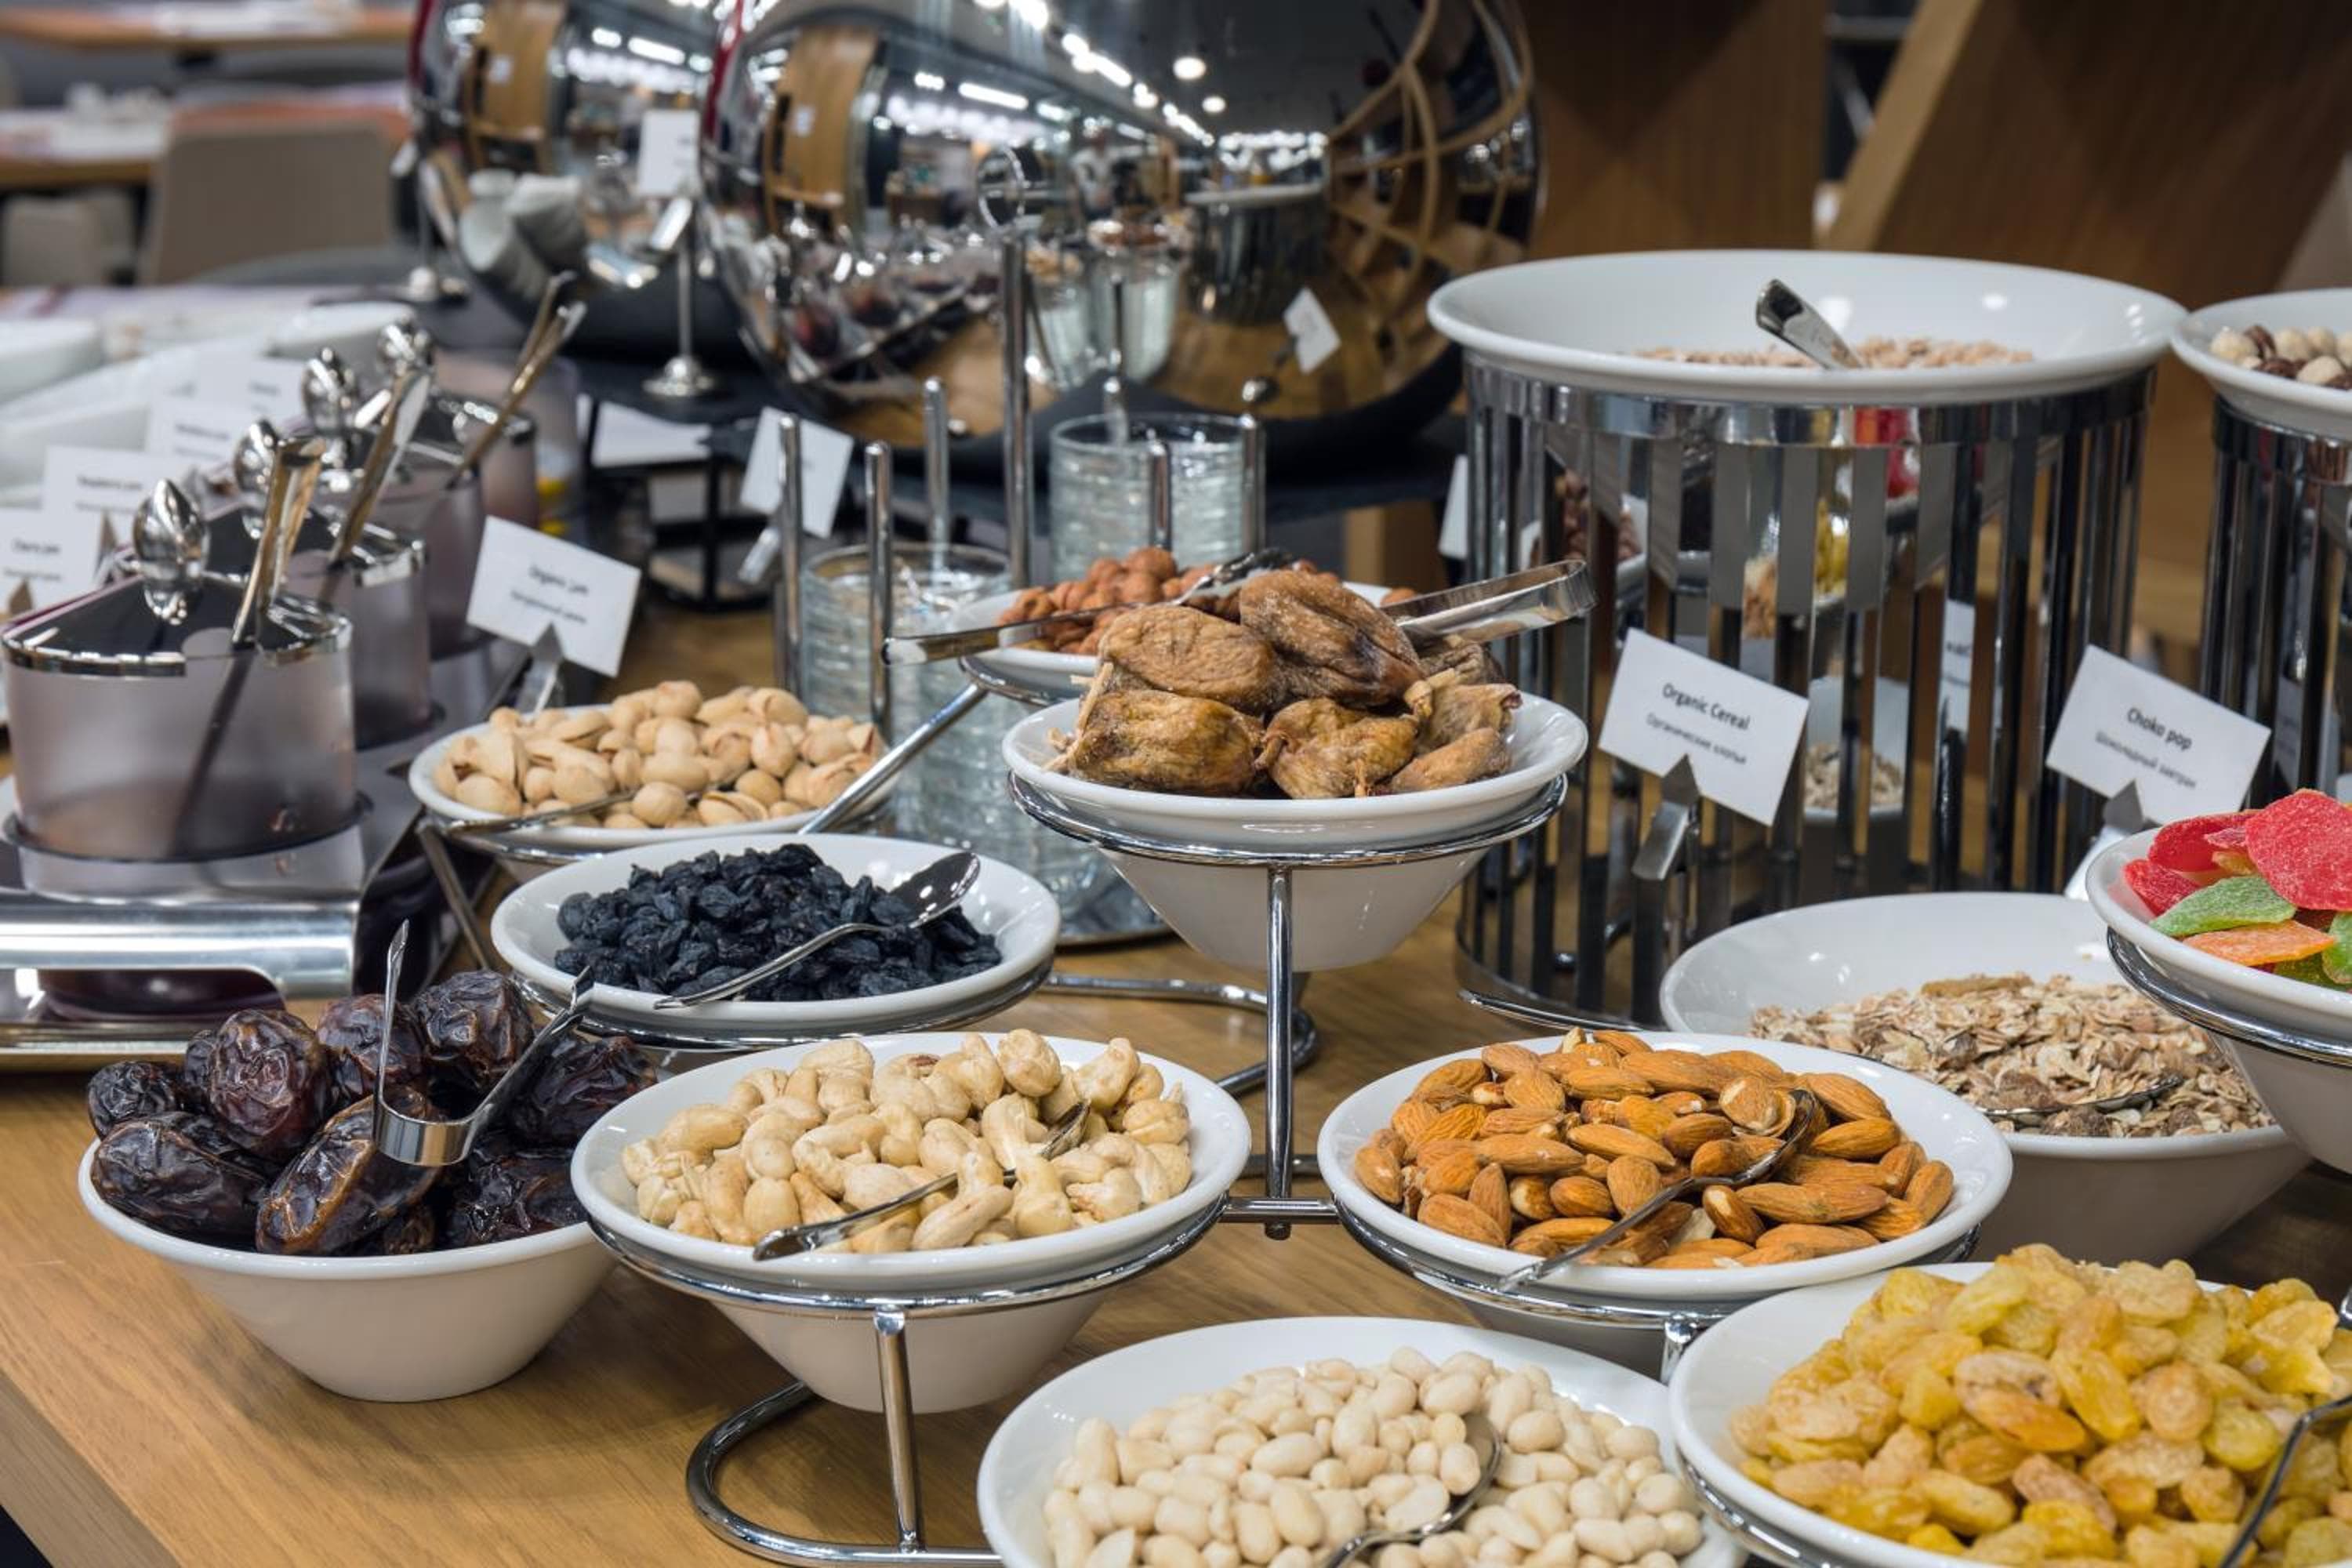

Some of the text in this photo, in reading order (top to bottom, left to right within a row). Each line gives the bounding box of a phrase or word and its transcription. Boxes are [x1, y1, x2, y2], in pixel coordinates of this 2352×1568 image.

[1662, 683, 1751, 731] Organic Cereal
[2127, 706, 2192, 752] Choko pop
